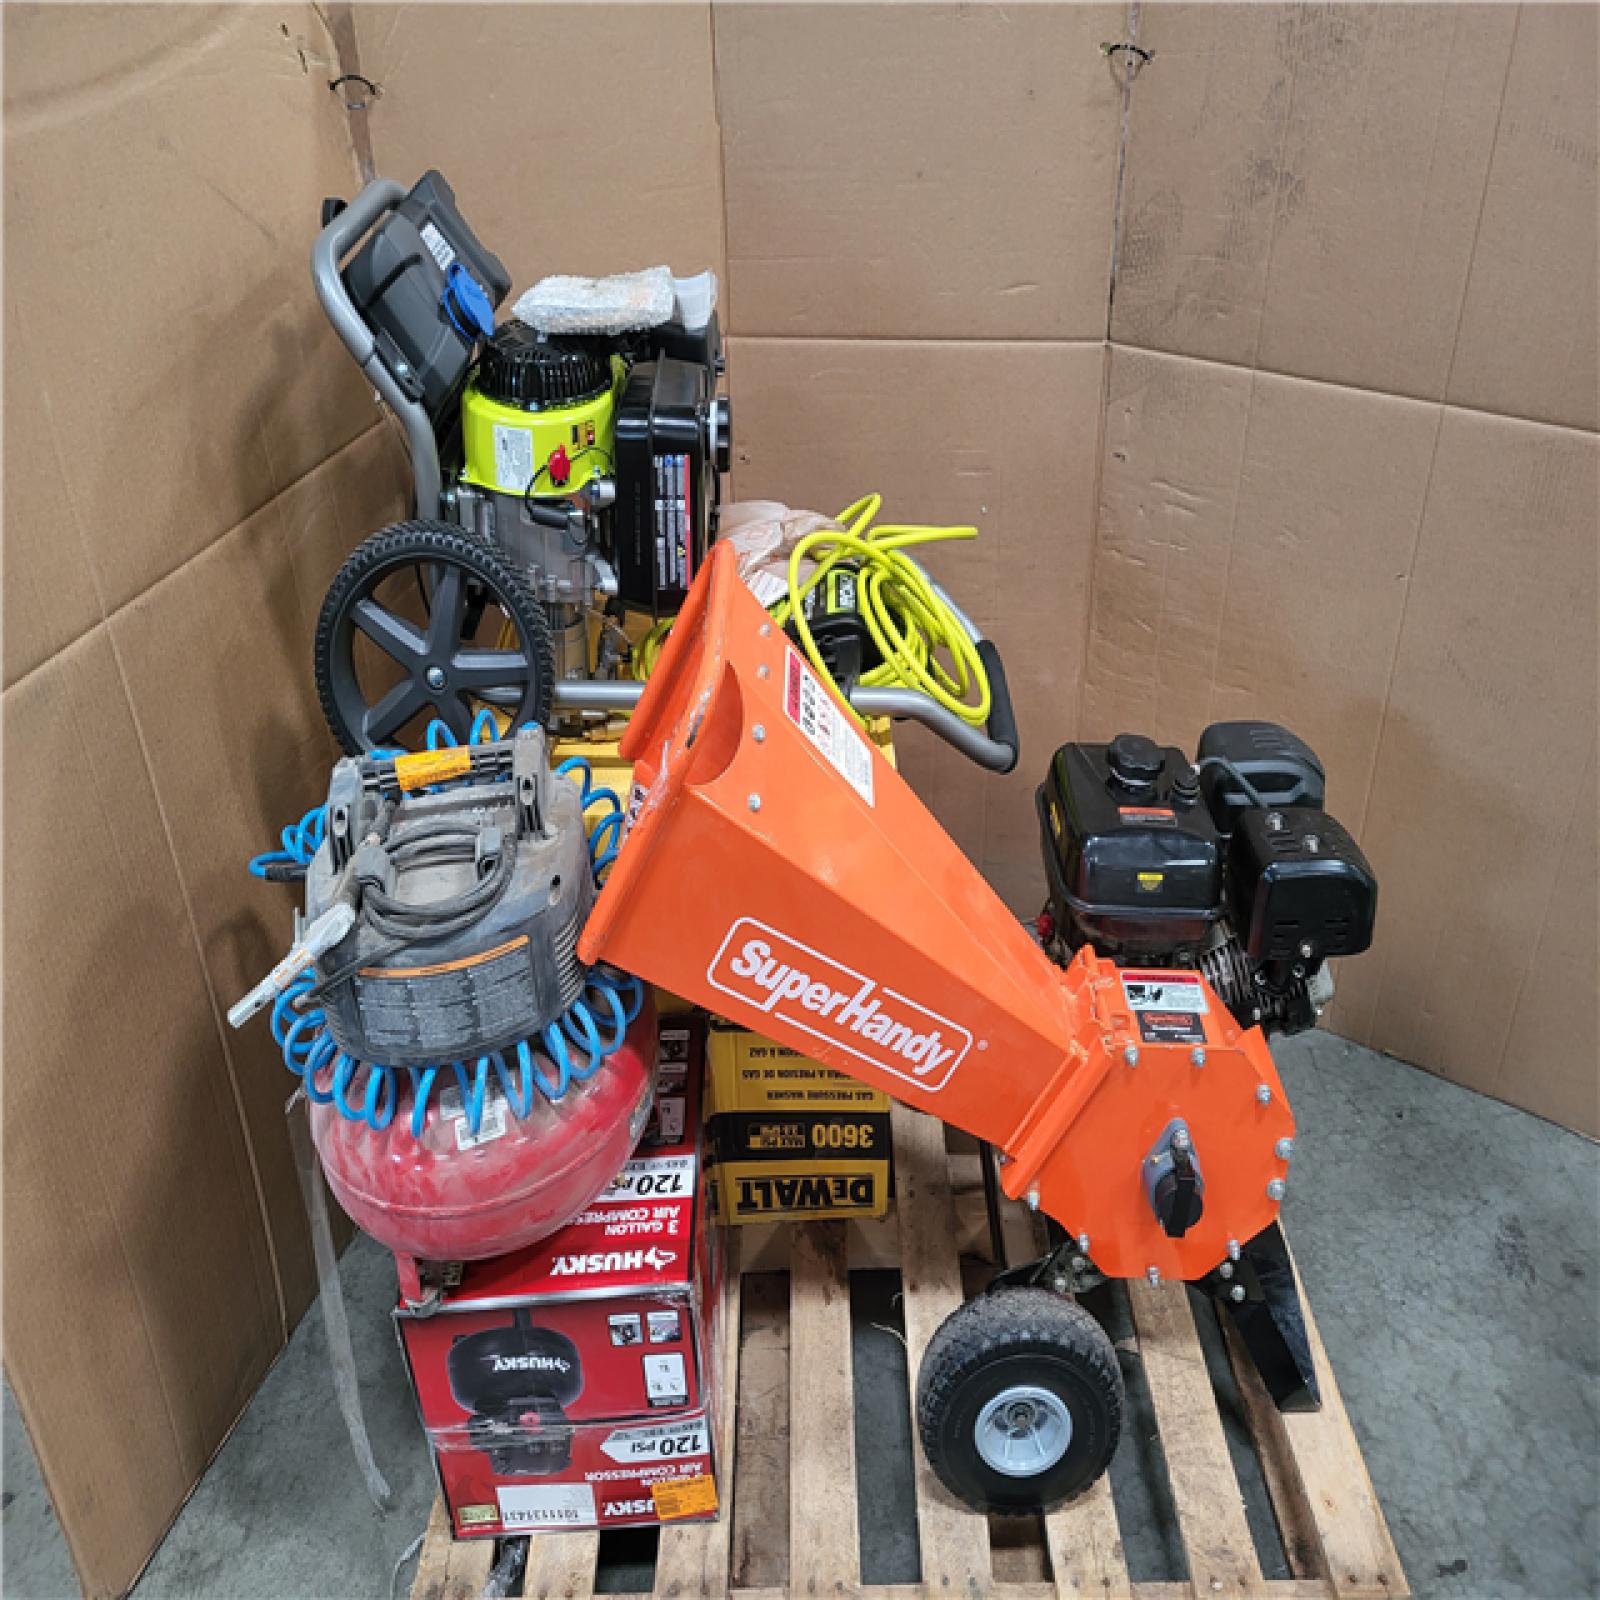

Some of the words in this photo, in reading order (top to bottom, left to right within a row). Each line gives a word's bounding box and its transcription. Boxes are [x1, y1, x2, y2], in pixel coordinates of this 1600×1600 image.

[730, 939, 956, 1077] SuperHandy
[767, 1090, 805, 1101] WASHER
[807, 1090, 853, 1101] PRESSURE
[855, 1090, 873, 1101] GAS
[811, 1124, 874, 1149] 3600
[636, 1174, 683, 1196] 120
[652, 1205, 681, 1219] AIR
[605, 1221, 664, 1236] GALLON
[667, 1219, 679, 1236] 3
[549, 1248, 644, 1276] HUSKY
[493, 1355, 553, 1371] HUSKY
[631, 1439, 656, 1453] PSI
[659, 1434, 702, 1456] 120
[584, 1464, 676, 1481] COMPRESSOR
[679, 1462, 703, 1476] AIR
[604, 1499, 655, 1516] USKY
